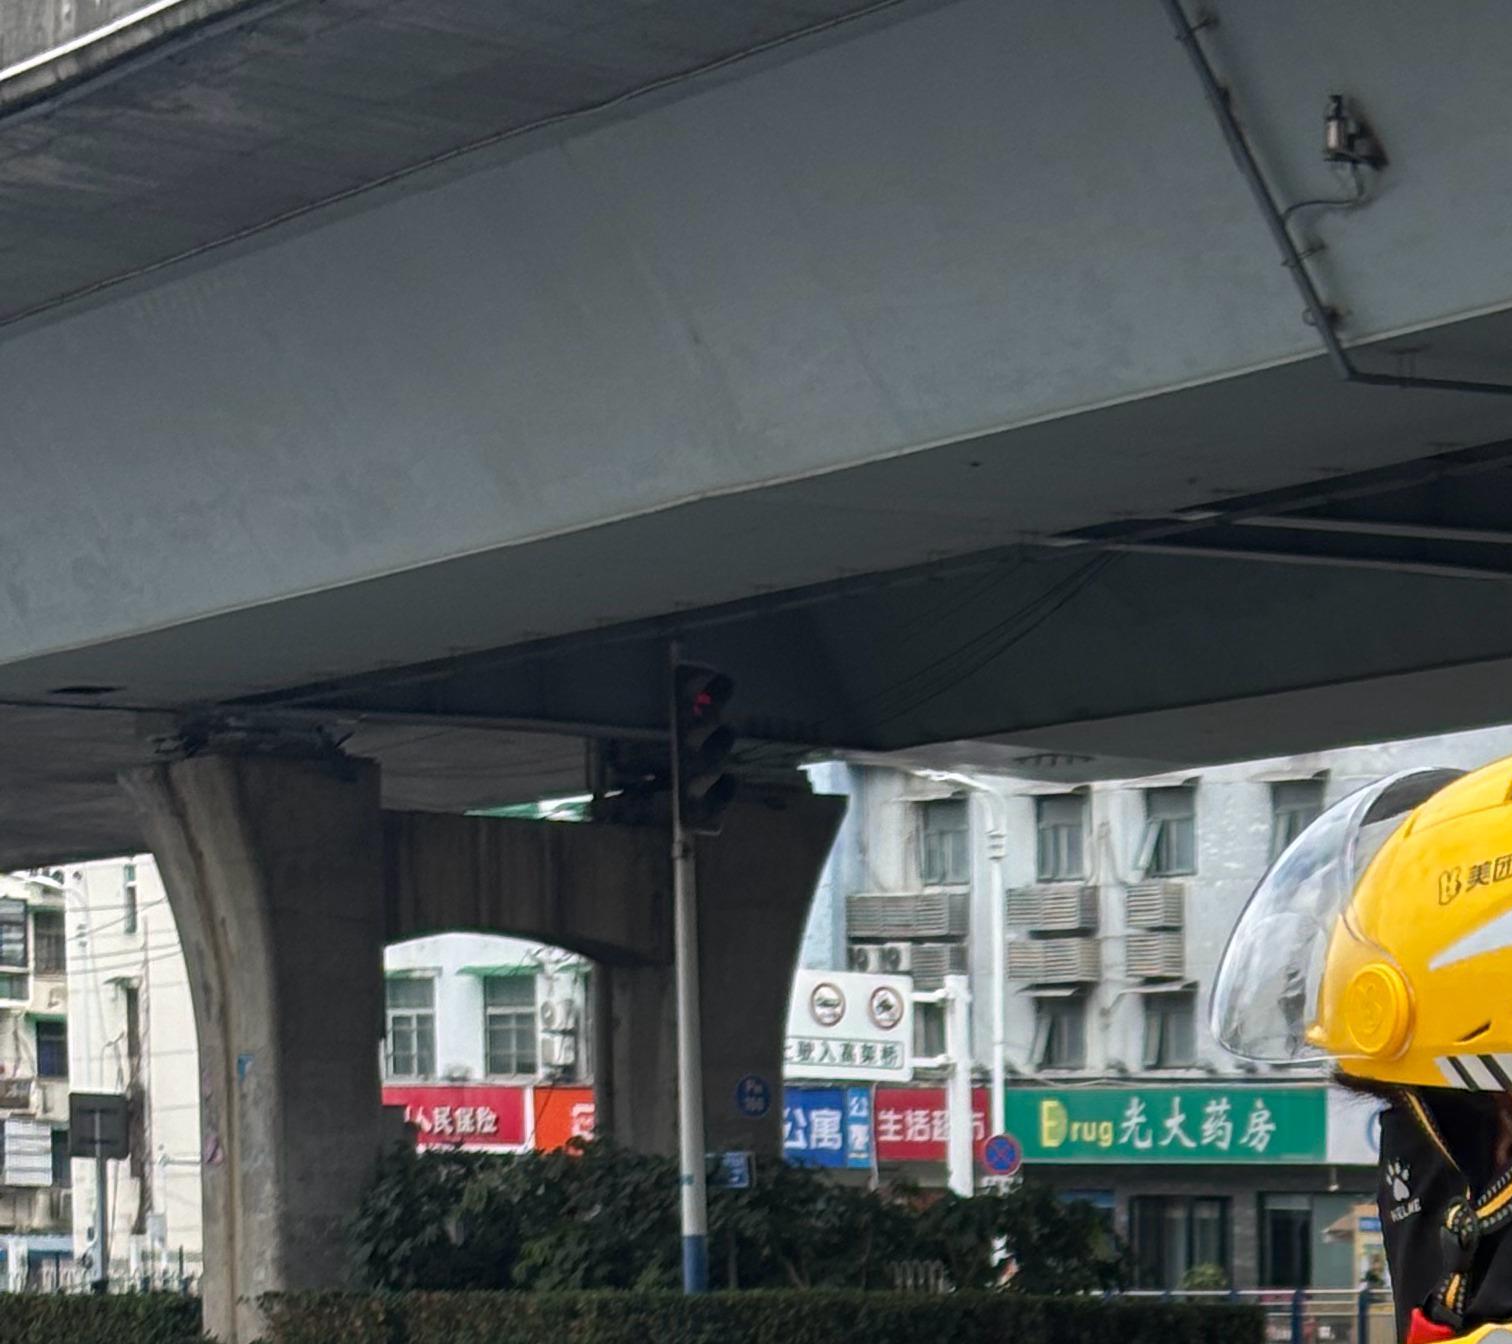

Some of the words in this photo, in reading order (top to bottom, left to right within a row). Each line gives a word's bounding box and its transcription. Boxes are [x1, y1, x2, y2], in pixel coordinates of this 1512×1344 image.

[784, 1107, 842, 1150] 公寓
[1119, 1096, 1277, 1151] 光大药房
